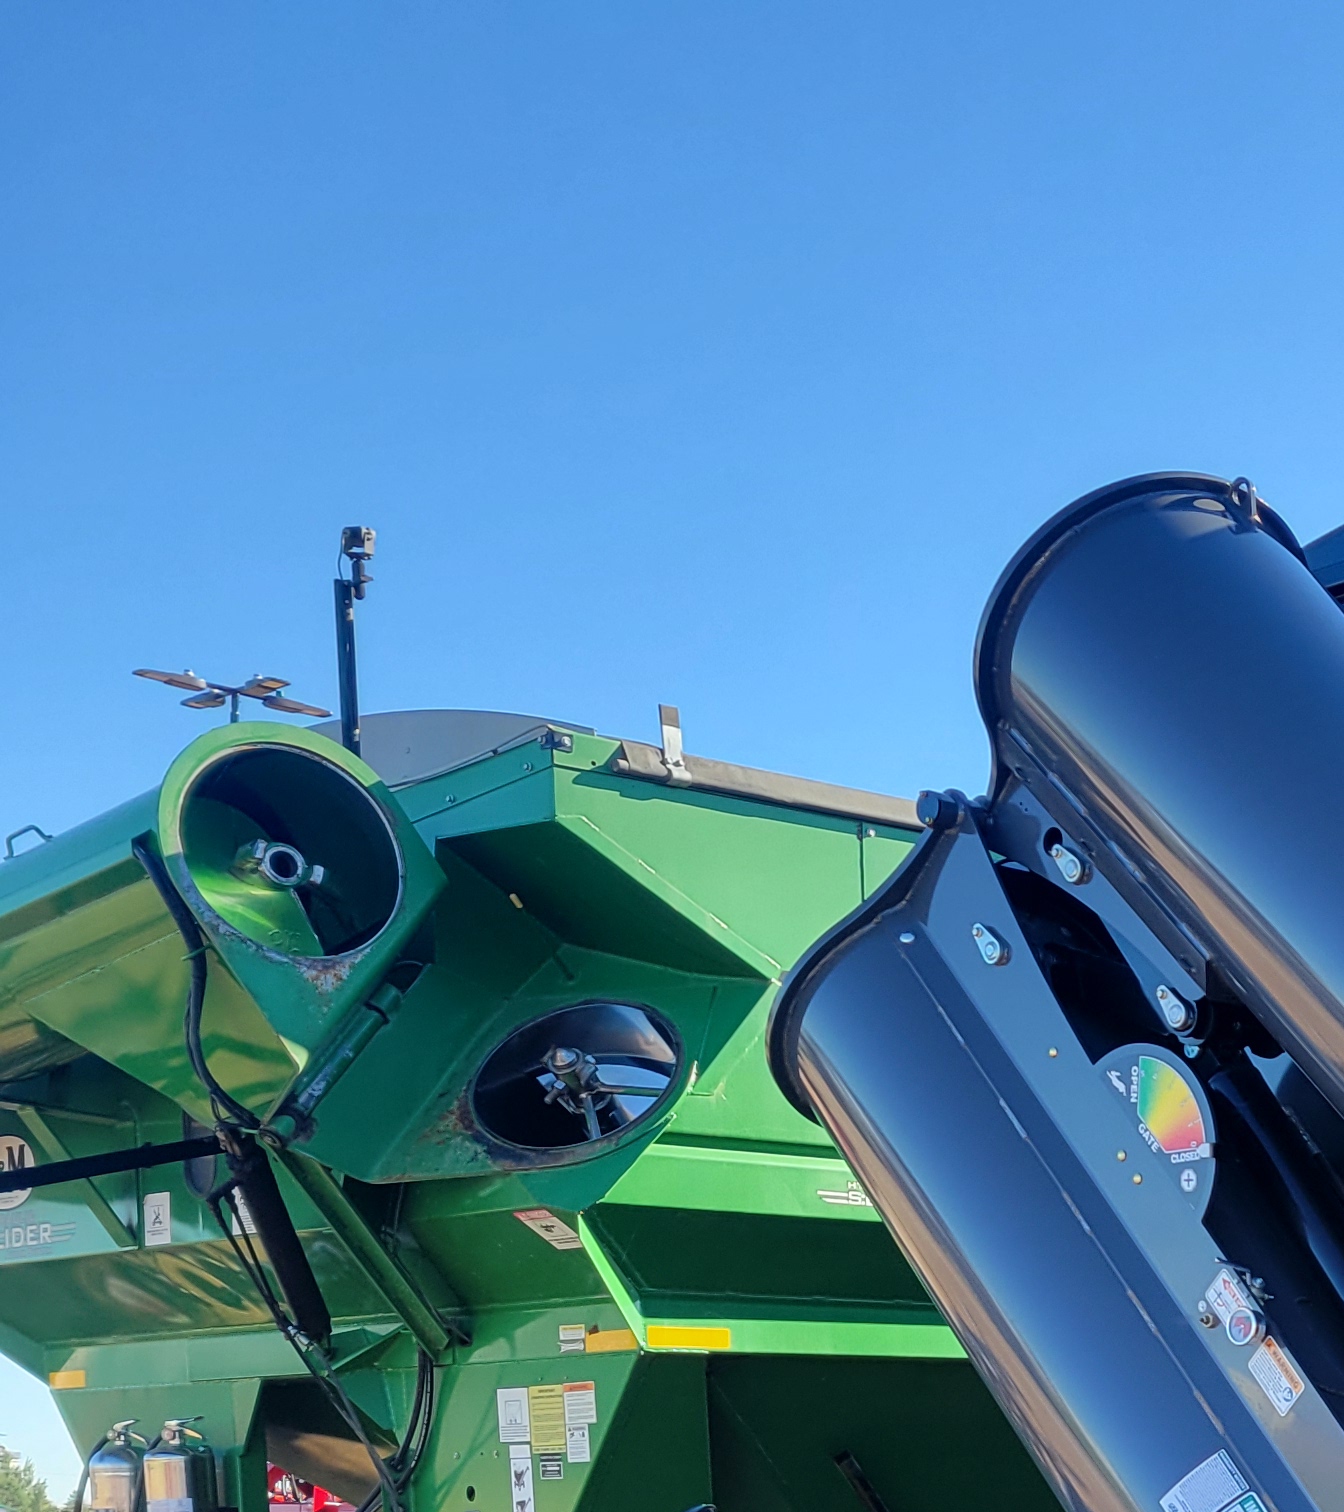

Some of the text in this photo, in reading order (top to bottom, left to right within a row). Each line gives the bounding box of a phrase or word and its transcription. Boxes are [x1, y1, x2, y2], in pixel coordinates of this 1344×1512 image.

[1130, 1066, 1138, 1103] OPEN
[1138, 1123, 1160, 1154] GATE
[1170, 1151, 1201, 1164] CLOSED
[1272, 1349, 1299, 1389] WARNING
